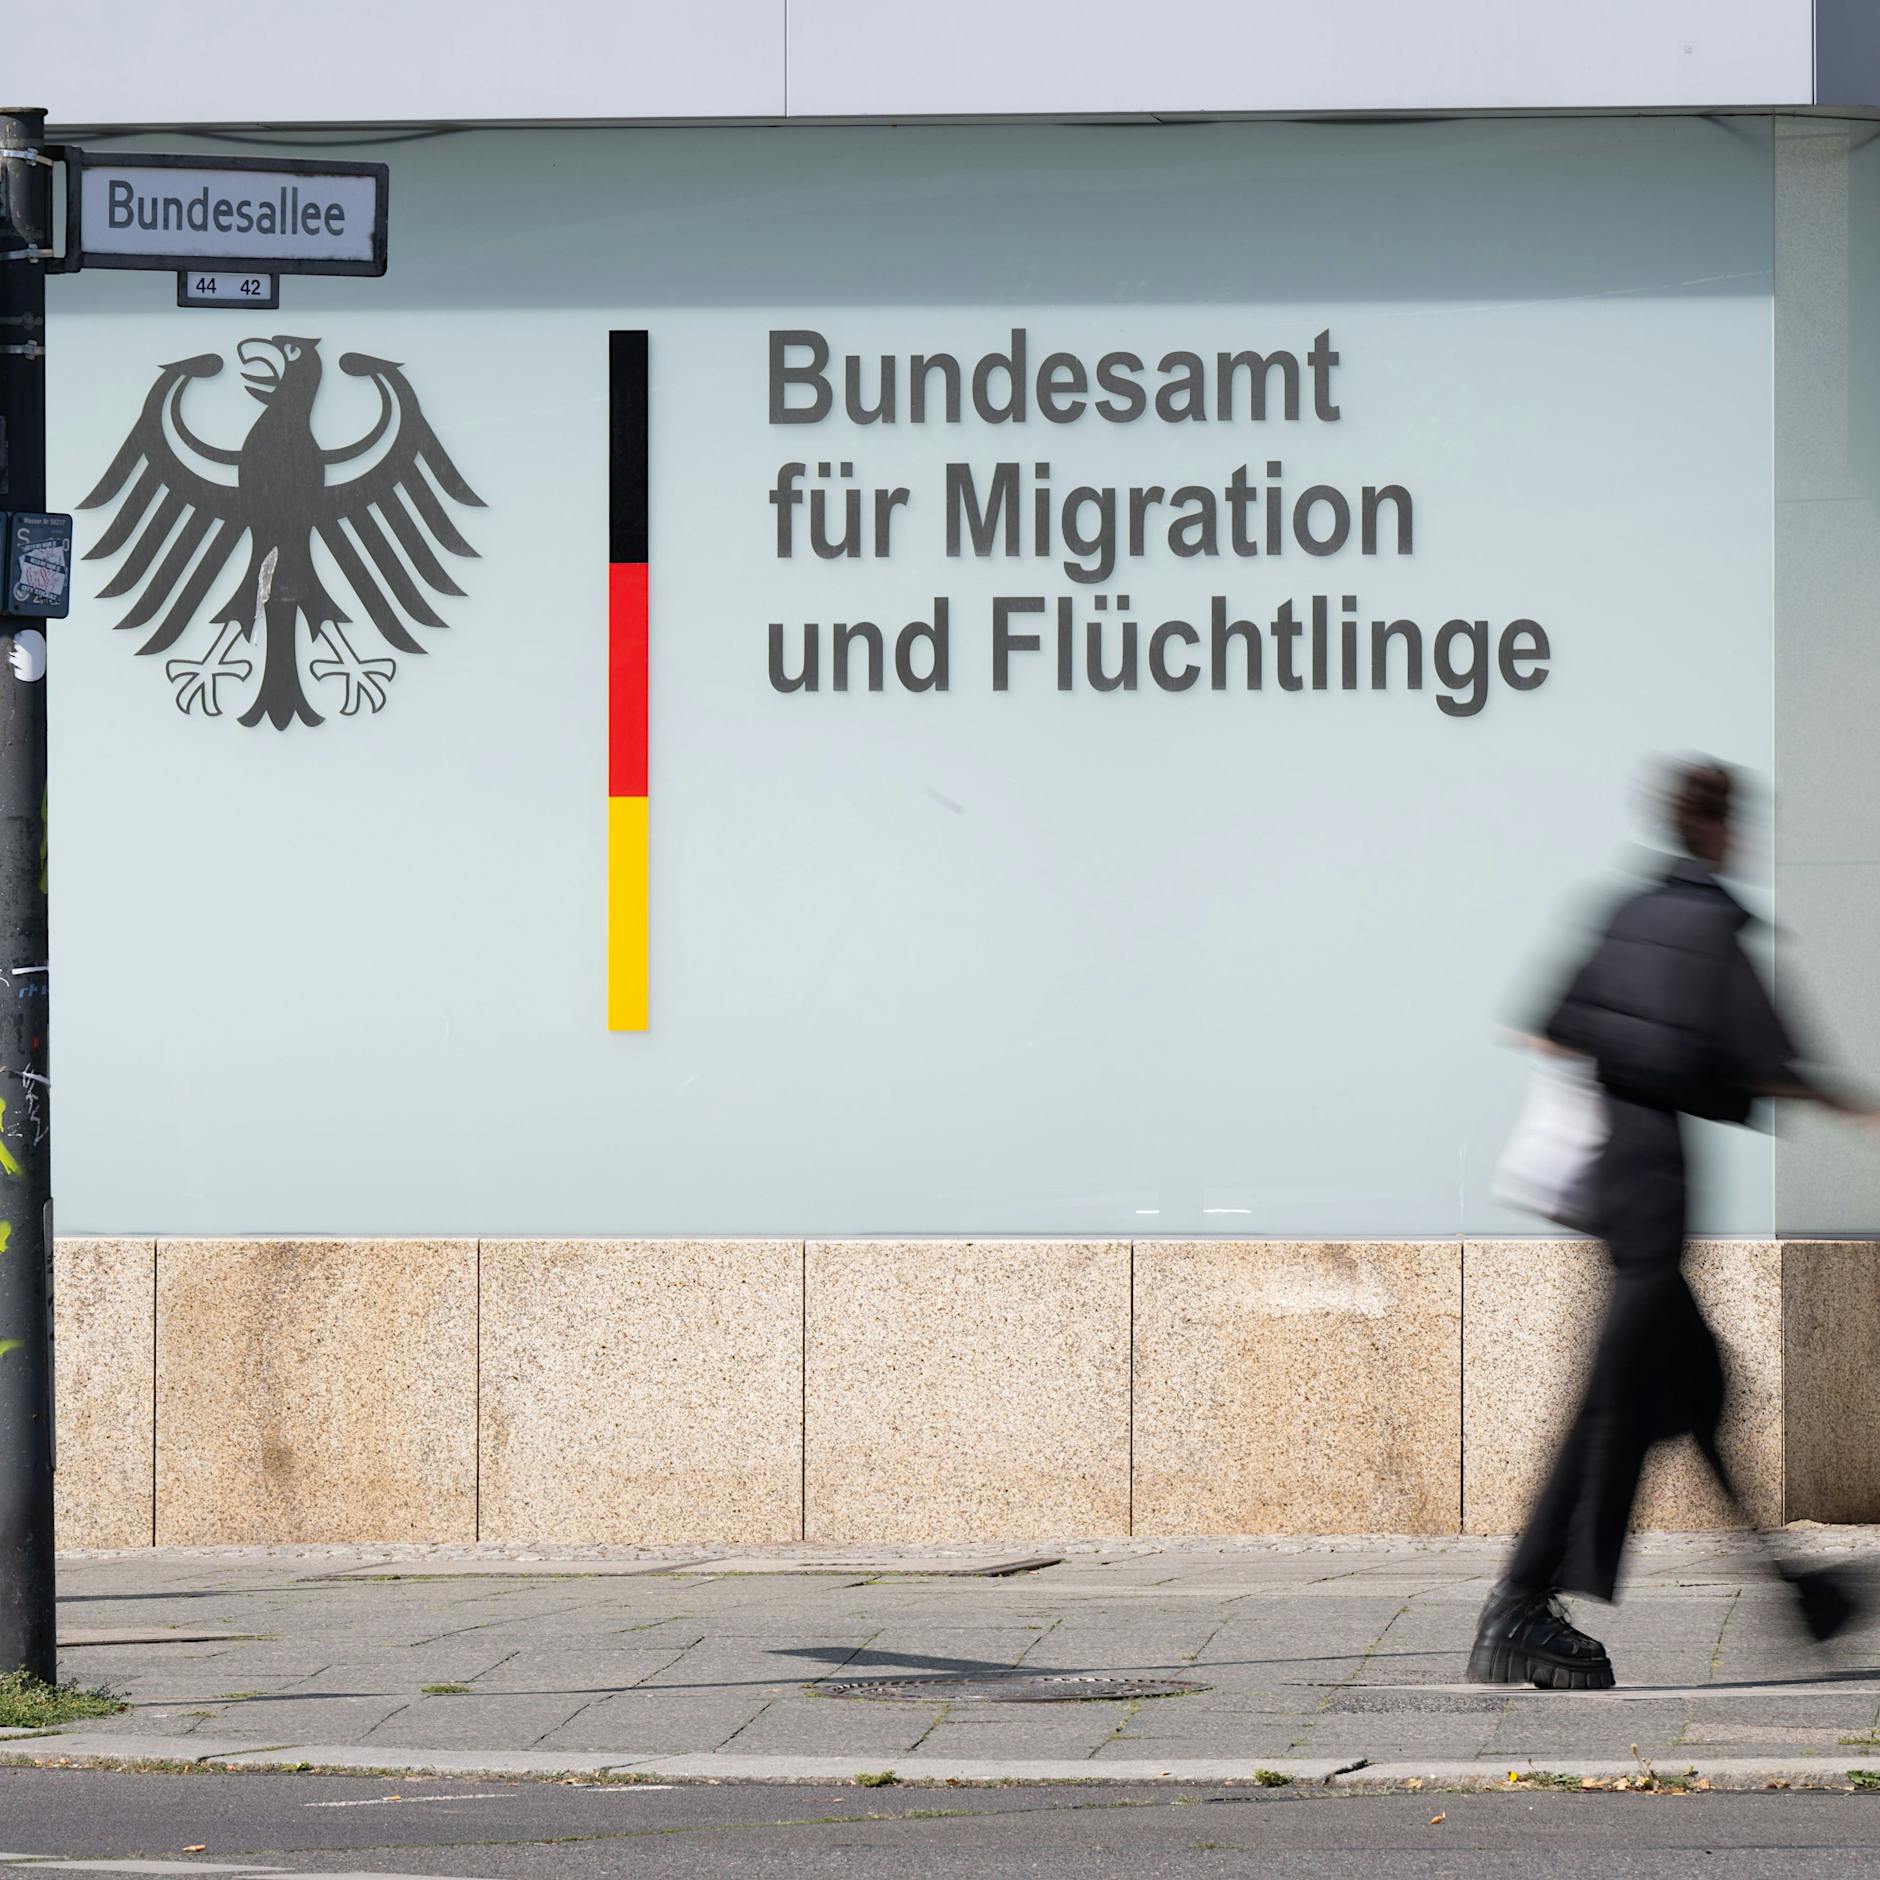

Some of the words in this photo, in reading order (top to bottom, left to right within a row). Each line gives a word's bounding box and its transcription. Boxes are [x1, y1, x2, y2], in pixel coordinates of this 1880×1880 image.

[107, 178, 346, 237] Bundesallee
[195, 277, 217, 294] 44
[240, 279, 262, 296] 42
[768, 327, 1341, 426] Bundesamt
[769, 461, 911, 560] für
[945, 460, 1413, 585] Migration
[768, 596, 950, 694] und
[992, 594, 1551, 718] Flüchtlinge
